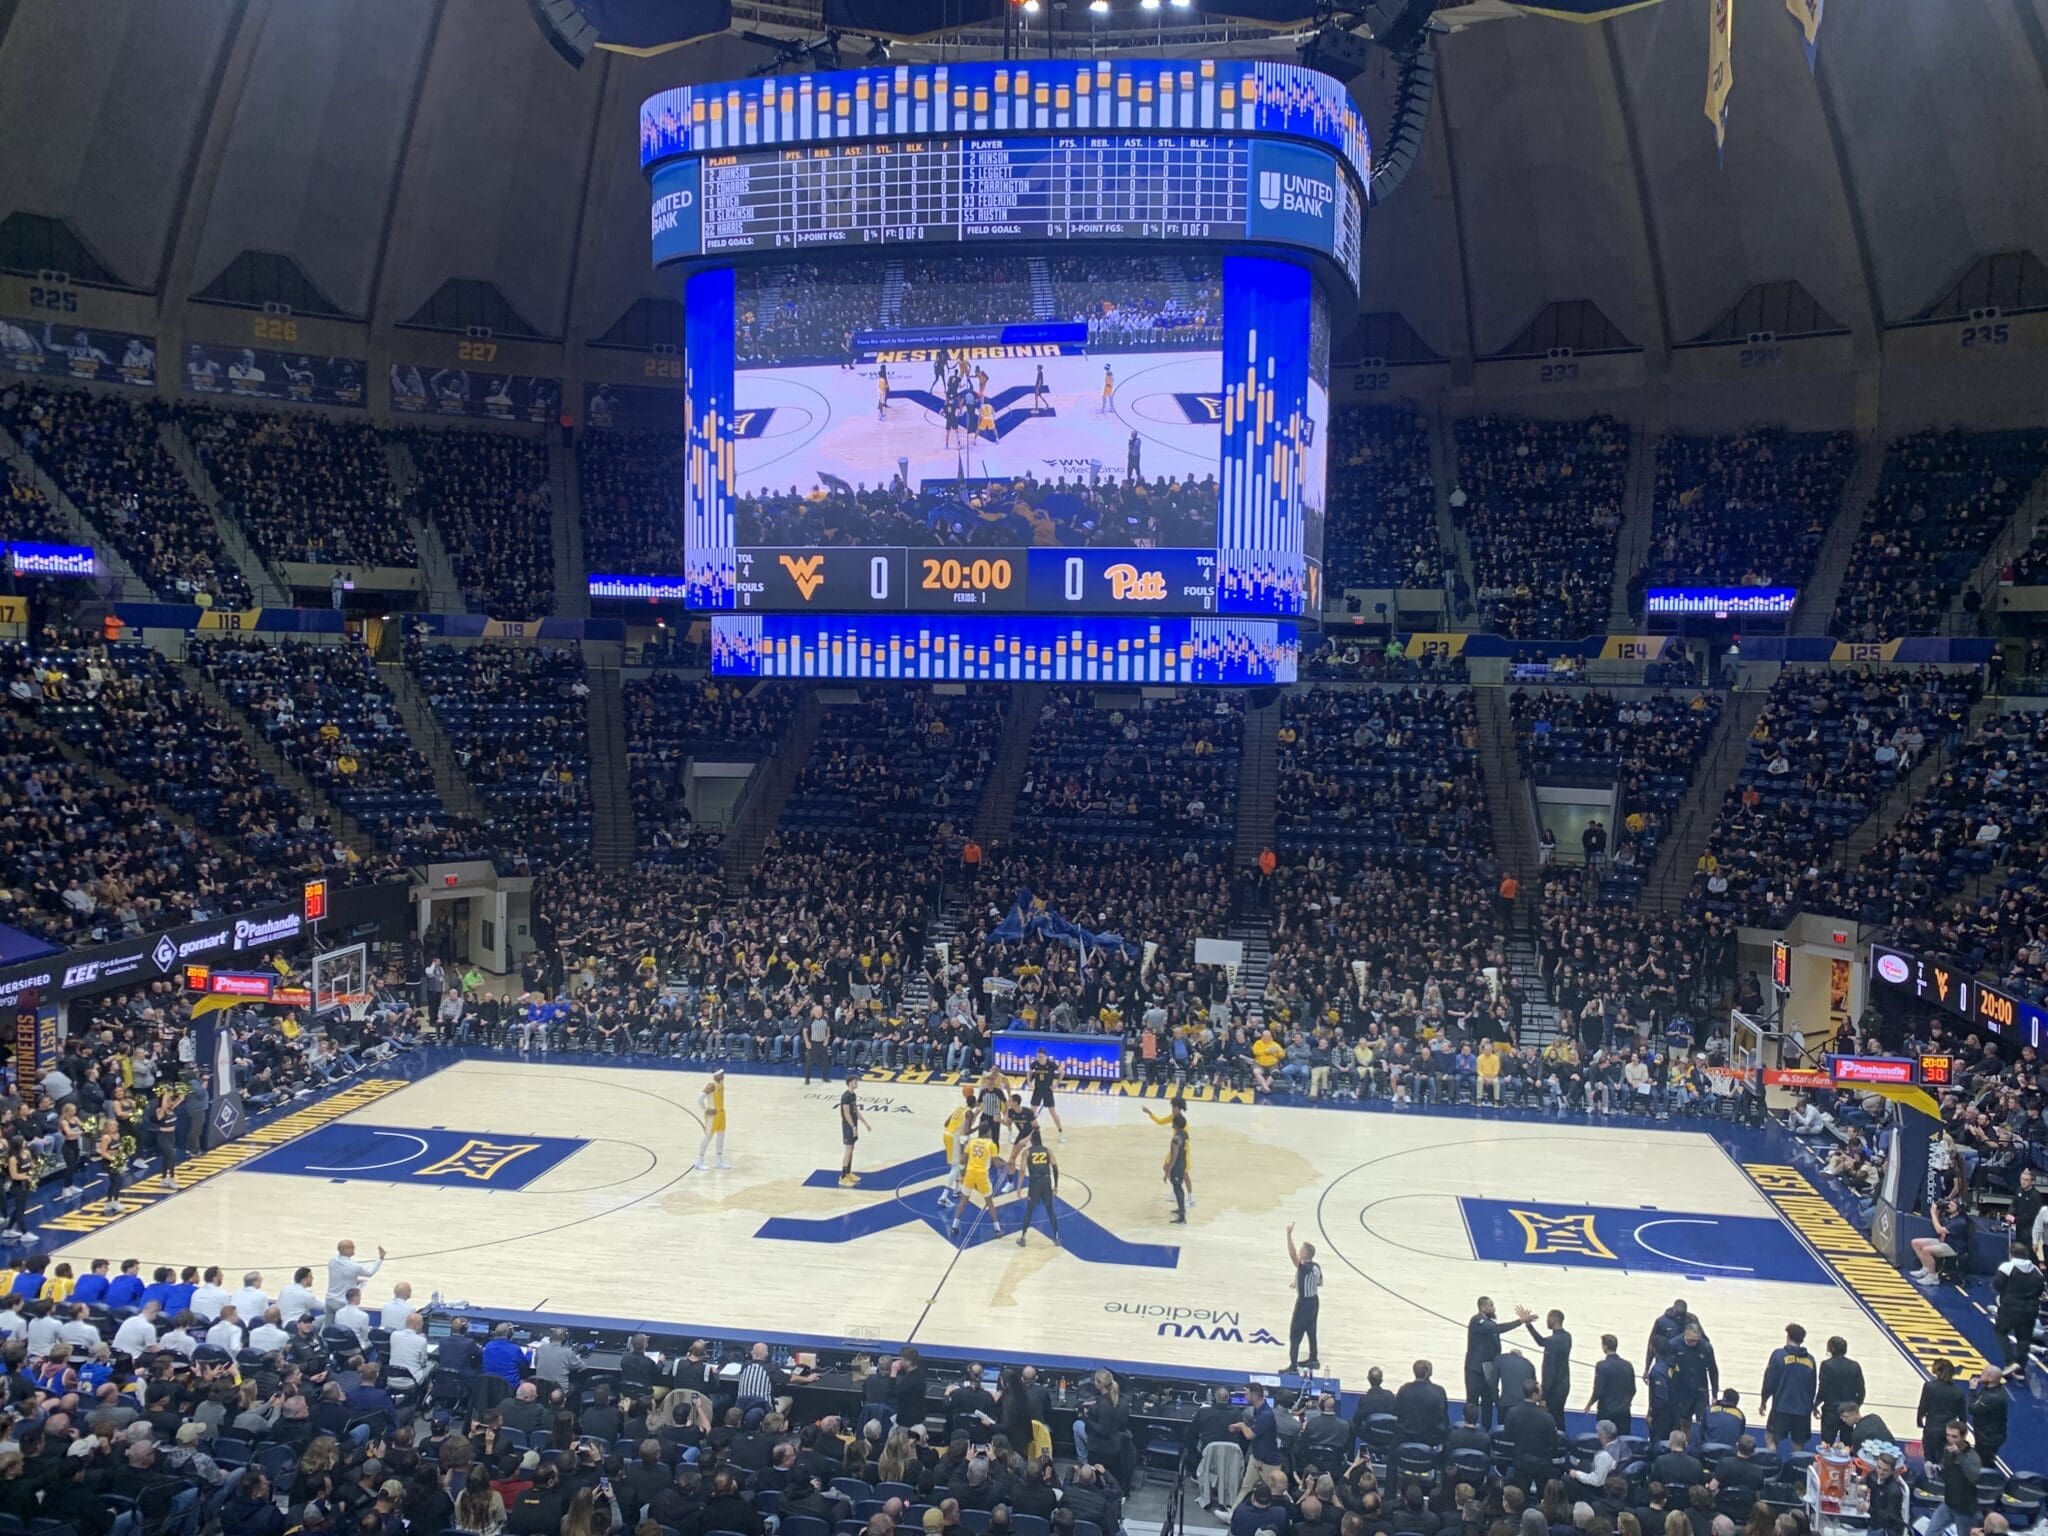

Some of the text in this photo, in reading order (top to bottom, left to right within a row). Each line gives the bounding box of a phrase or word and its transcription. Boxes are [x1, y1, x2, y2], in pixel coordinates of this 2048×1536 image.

[971, 139, 1233, 149] PLAYER PTS. REB. AST. STL. BLK. F
[709, 142, 948, 166] PLAYER PTS. REB. AST. STL. BLK. F
[970, 152, 1009, 165] 2 HINSON
[709, 154, 947, 181] 2 JOHNSON 0 0 0 0 0 0
[969, 167, 1012, 179] 5 LEGGETT
[709, 184, 714, 195] 7
[970, 180, 1029, 193] 7 CARRINGTON
[1284, 174, 1333, 203] UNITED
[964, 195, 974, 207] 33
[1283, 193, 1323, 218] BANK
[964, 209, 1007, 221] 55 AUSTIN
[705, 222, 743, 237] 22 HARRIS
[798, 229, 878, 242] 3-POINT FGS: 0 %
[886, 227, 924, 240] FT: 0 OF 0
[967, 224, 1062, 236] FIELD GOALS: 0 %
[1143, 223, 1148, 236] 0
[1150, 224, 1158, 232] %
[1182, 223, 1188, 236] 0
[1190, 223, 1201, 236] OF
[1203, 223, 1208, 236] 0
[707, 234, 790, 248] FIELD GOALS: 0 %
[30, 286, 77, 313] 225
[254, 317, 298, 342] 226
[1961, 325, 2009, 347] 235
[458, 341, 498, 362] 227
[876, 345, 1061, 364] WEST VIRGINIA
[644, 359, 682, 377] 228
[1540, 363, 1578, 382] 233
[1352, 372, 1390, 391] 232
[737, 554, 754, 563] TOL
[1196, 557, 1215, 566] TOL
[743, 565, 749, 577] 4
[871, 557, 888, 599] 0
[922, 559, 1012, 589] 20:00
[1065, 557, 1083, 600] 0
[1203, 567, 1210, 580] 4
[737, 583, 764, 591] FOULS
[1104, 563, 1167, 600] Pitt
[982, 592, 986, 603] 1
[1183, 587, 1215, 596] FOULS
[744, 593, 750, 606] 0
[1204, 597, 1211, 609] 0
[219, 614, 240, 629] 118
[502, 623, 525, 637] 119
[1617, 643, 1647, 659] 124
[1850, 645, 1881, 661] 125
[307, 895, 321, 917] 30
[248, 913, 301, 938] Panhandle
[178, 931, 227, 958] gomart
[190, 977, 204, 988] 30
[1960, 983, 1967, 1012] 0
[1980, 990, 2012, 1025] 20:00
[2031, 1016, 2039, 1048] 0
[1853, 1064, 1906, 1076] Panhandle
[1922, 1057, 1948, 1068] 20:00
[1927, 1068, 1944, 1081] 30
[237, 1079, 411, 1144] MOUNTAINEERS
[973, 1146, 985, 1158] 55
[1031, 1152, 1048, 1164] 22
[1742, 1163, 1818, 1196] WEST
[1771, 1195, 1877, 1254] VIRGINIA
[1104, 1301, 1239, 1326] Medicine
[1157, 1322, 1244, 1343] WVU
[1829, 1469, 1840, 1481] G
